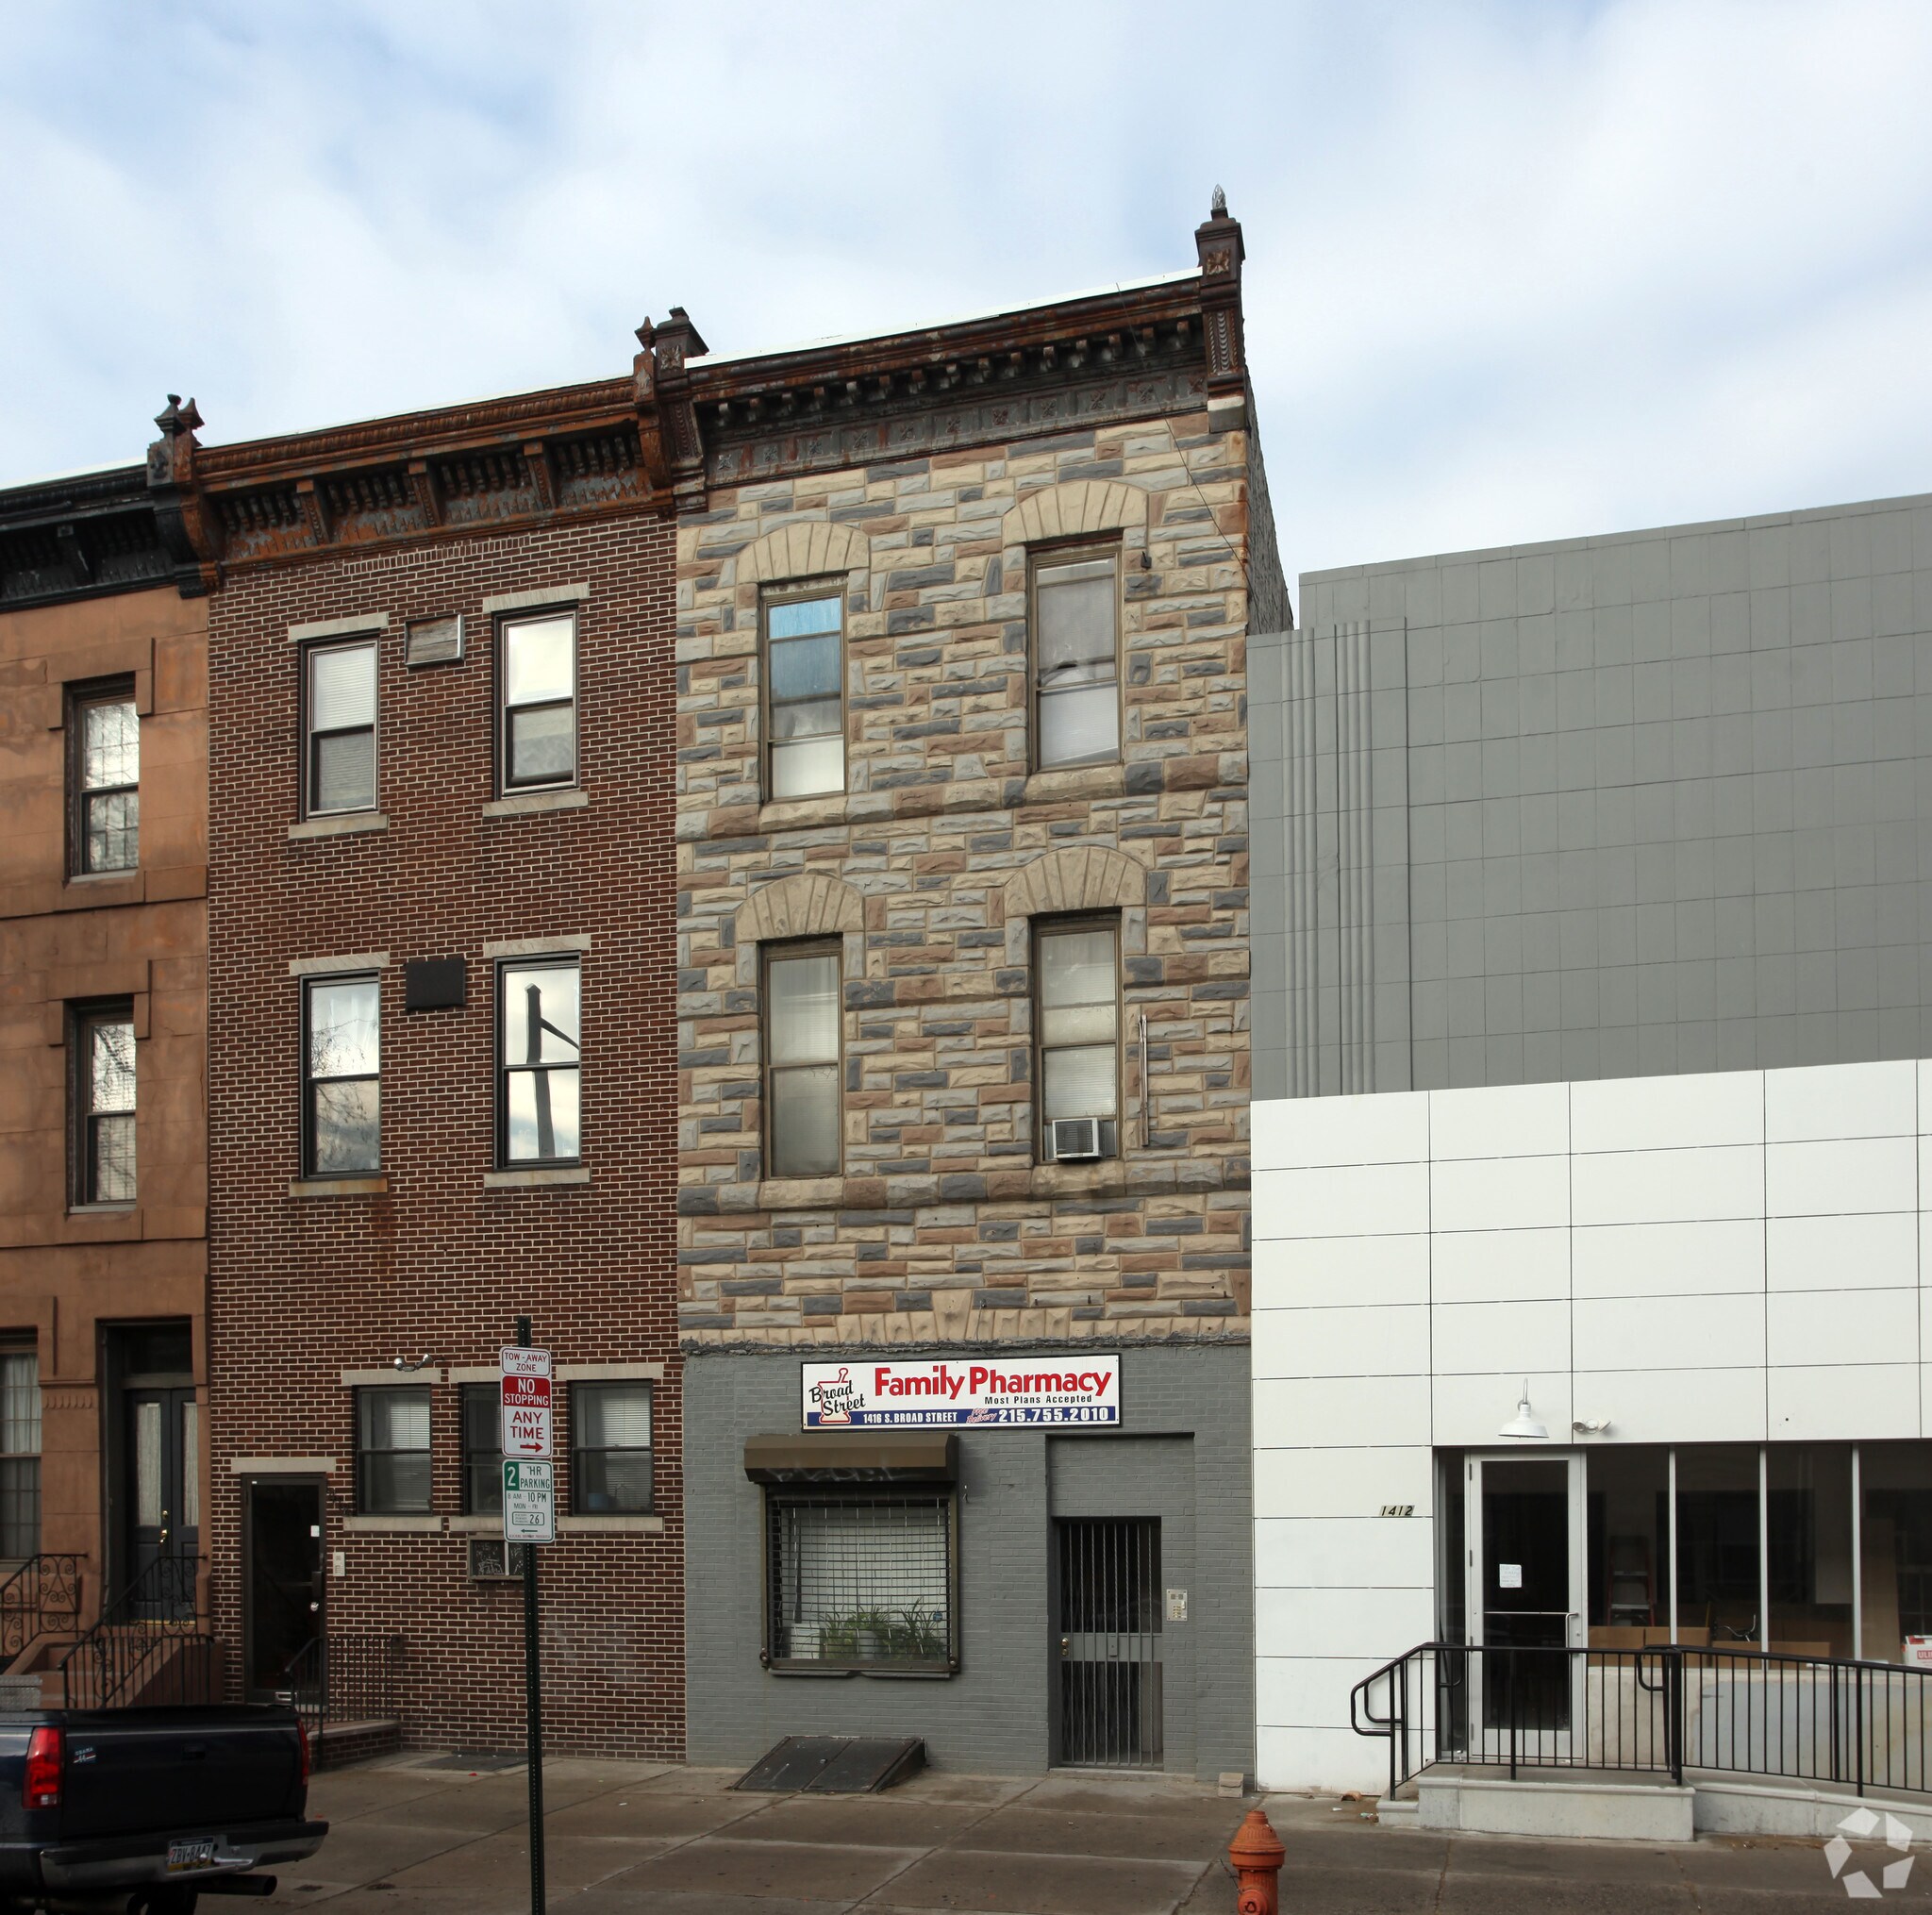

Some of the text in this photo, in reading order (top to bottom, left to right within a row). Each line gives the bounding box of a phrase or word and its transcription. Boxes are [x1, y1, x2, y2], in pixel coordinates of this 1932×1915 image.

[505, 1352, 520, 1360] TOW
[526, 1354, 547, 1362] AWAY
[516, 1363, 537, 1372] ZONE
[518, 1378, 535, 1393] NO
[874, 1365, 1112, 1400] Family Pharmacy
[808, 1380, 854, 1404] Broad
[505, 1393, 549, 1406] STOPPING
[823, 1393, 866, 1416] Street
[984, 1394, 1092, 1405] Most Plans Accepted
[512, 1410, 542, 1424] ANY
[863, 1412, 958, 1424] 1416 S. BROAD STREET
[998, 1407, 1108, 1423] 215.755.2010
[510, 1425, 544, 1440] TIME
[507, 1466, 542, 1487] 2 HR
[520, 1478, 550, 1489] PARKING
[527, 1492, 536, 1502] 10
[537, 1492, 547, 1503] PM
[1381, 1505, 1413, 1516] 1412
[529, 1514, 540, 1524] 26
